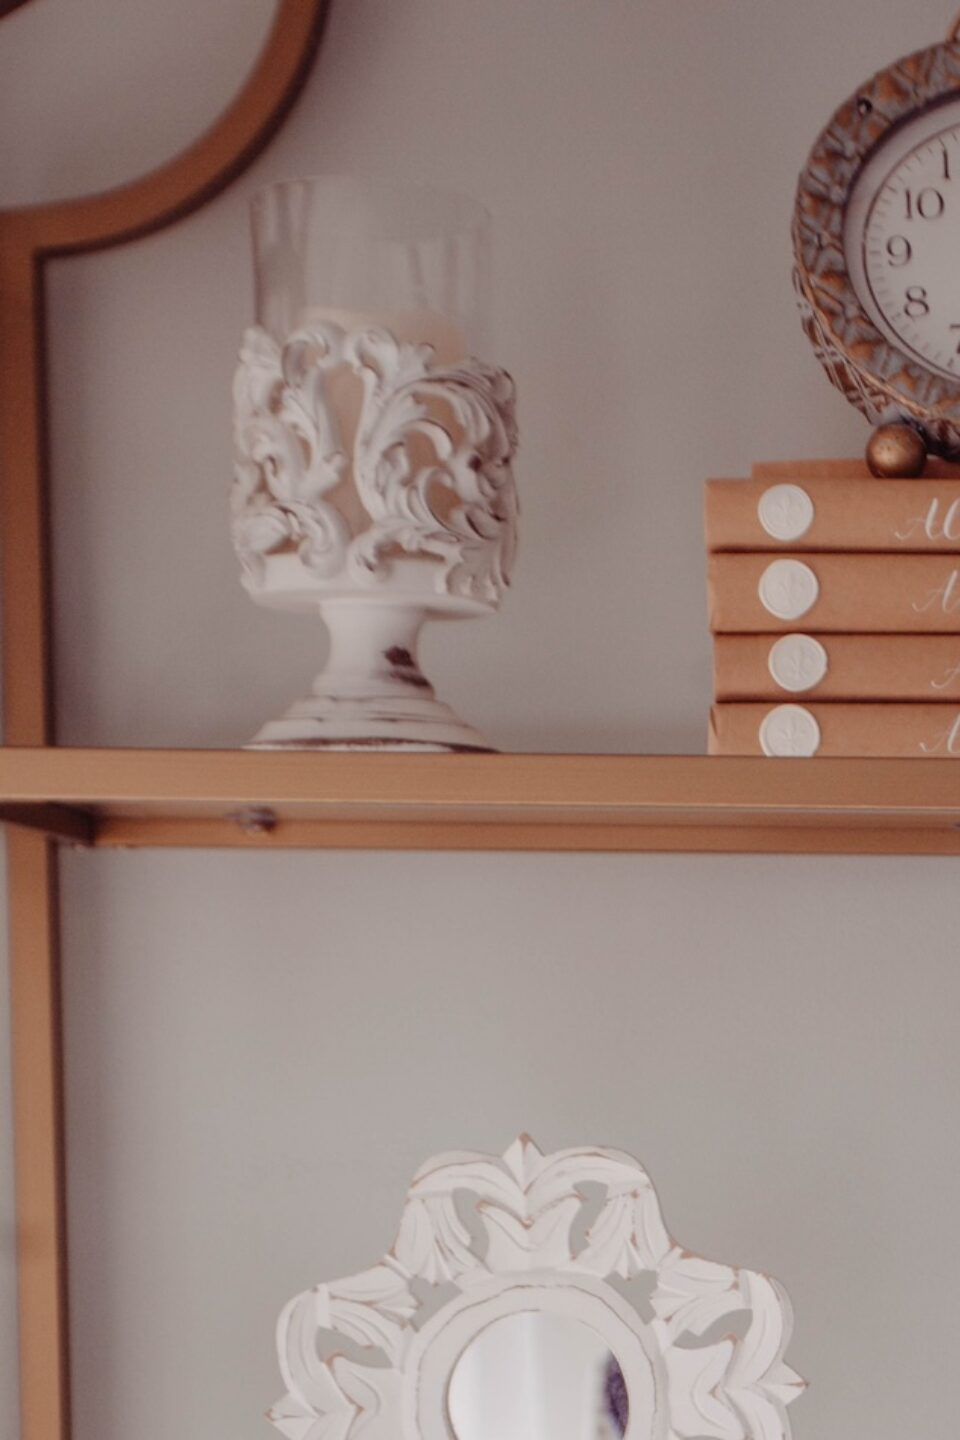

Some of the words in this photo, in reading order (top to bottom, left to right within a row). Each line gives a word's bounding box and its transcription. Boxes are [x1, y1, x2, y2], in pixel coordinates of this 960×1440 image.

[904, 188, 945, 219] 10
[886, 235, 912, 267] 9
[904, 286, 930, 318] 8
